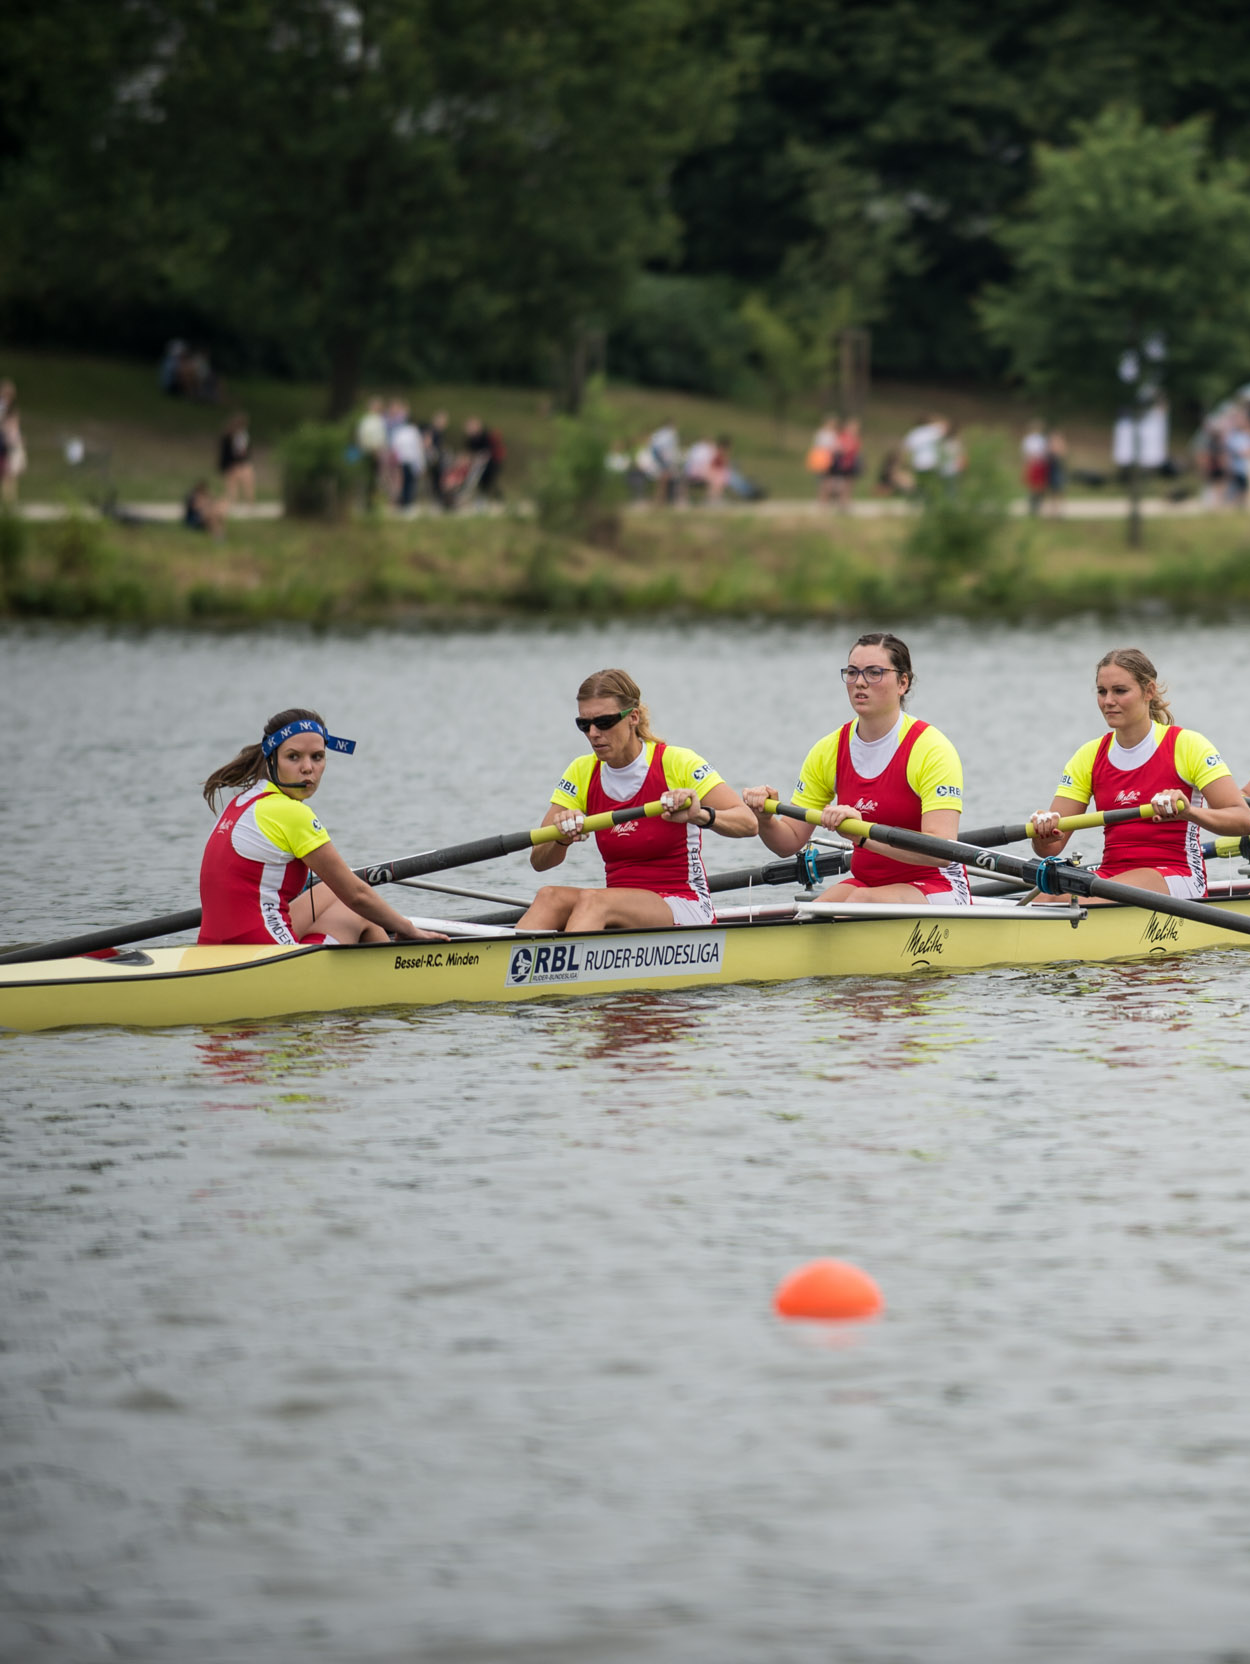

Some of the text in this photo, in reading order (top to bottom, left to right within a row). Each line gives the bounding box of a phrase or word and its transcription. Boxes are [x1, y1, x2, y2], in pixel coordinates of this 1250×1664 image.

[281, 726, 293, 739] NK
[299, 721, 313, 731] NK
[336, 740, 349, 751] NK
[559, 778, 577, 796] RBL
[1139, 911, 1180, 944] Melitta
[901, 920, 943, 957] Melitta
[446, 952, 480, 967] Minden
[534, 943, 719, 973] RBL RUDER-BUNDESLIGA
